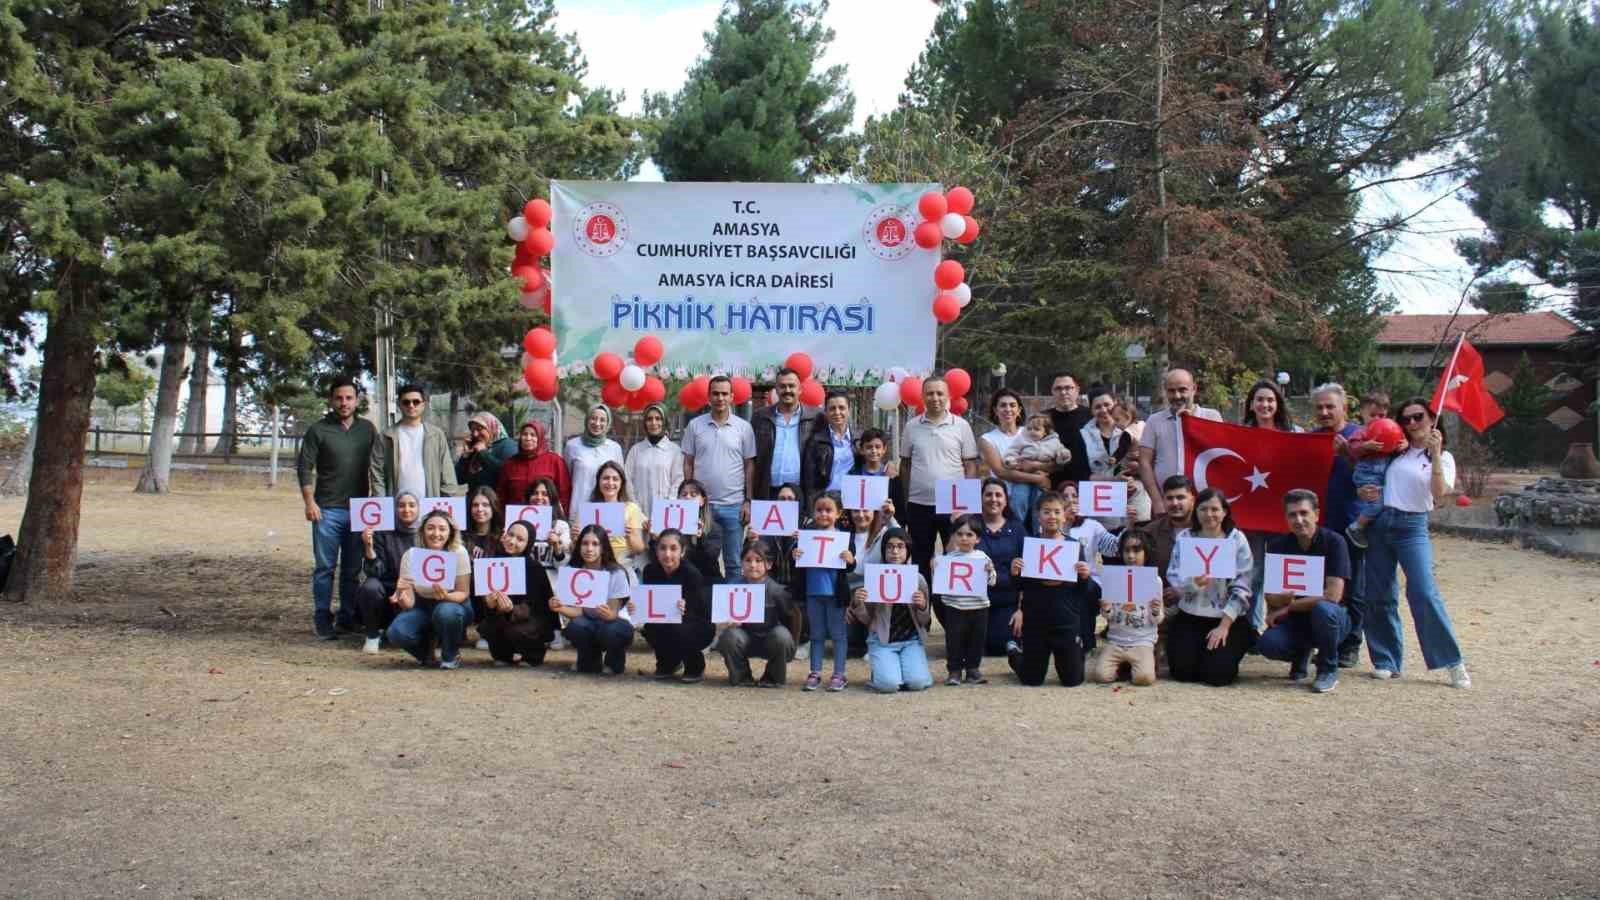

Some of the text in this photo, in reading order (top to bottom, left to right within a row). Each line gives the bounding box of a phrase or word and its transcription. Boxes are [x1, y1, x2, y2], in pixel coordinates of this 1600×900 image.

[732, 200, 761, 214] T.C.
[712, 222, 780, 236] AMASYA
[636, 241, 856, 262] CUMHURİYET BAŞSAVCILIĞI
[658, 271, 833, 289] AMASYA İCRA DAİRESİ
[613, 296, 873, 332] PİKNİK HATIRASI
[951, 484, 969, 511] L
[1093, 484, 1112, 512] E
[359, 500, 382, 527] G
[761, 504, 785, 531] A
[811, 536, 835, 564] T
[1038, 543, 1063, 576] K
[1194, 545, 1220, 578] Y
[421, 554, 446, 583] G
[487, 561, 510, 593] Ü
[948, 561, 974, 592] R
[1281, 557, 1307, 591] E
[569, 569, 594, 605] Ç
[879, 568, 902, 603] Ü
[1127, 568, 1133, 602] İ
[647, 589, 666, 619] L
[729, 587, 752, 622] Ü
